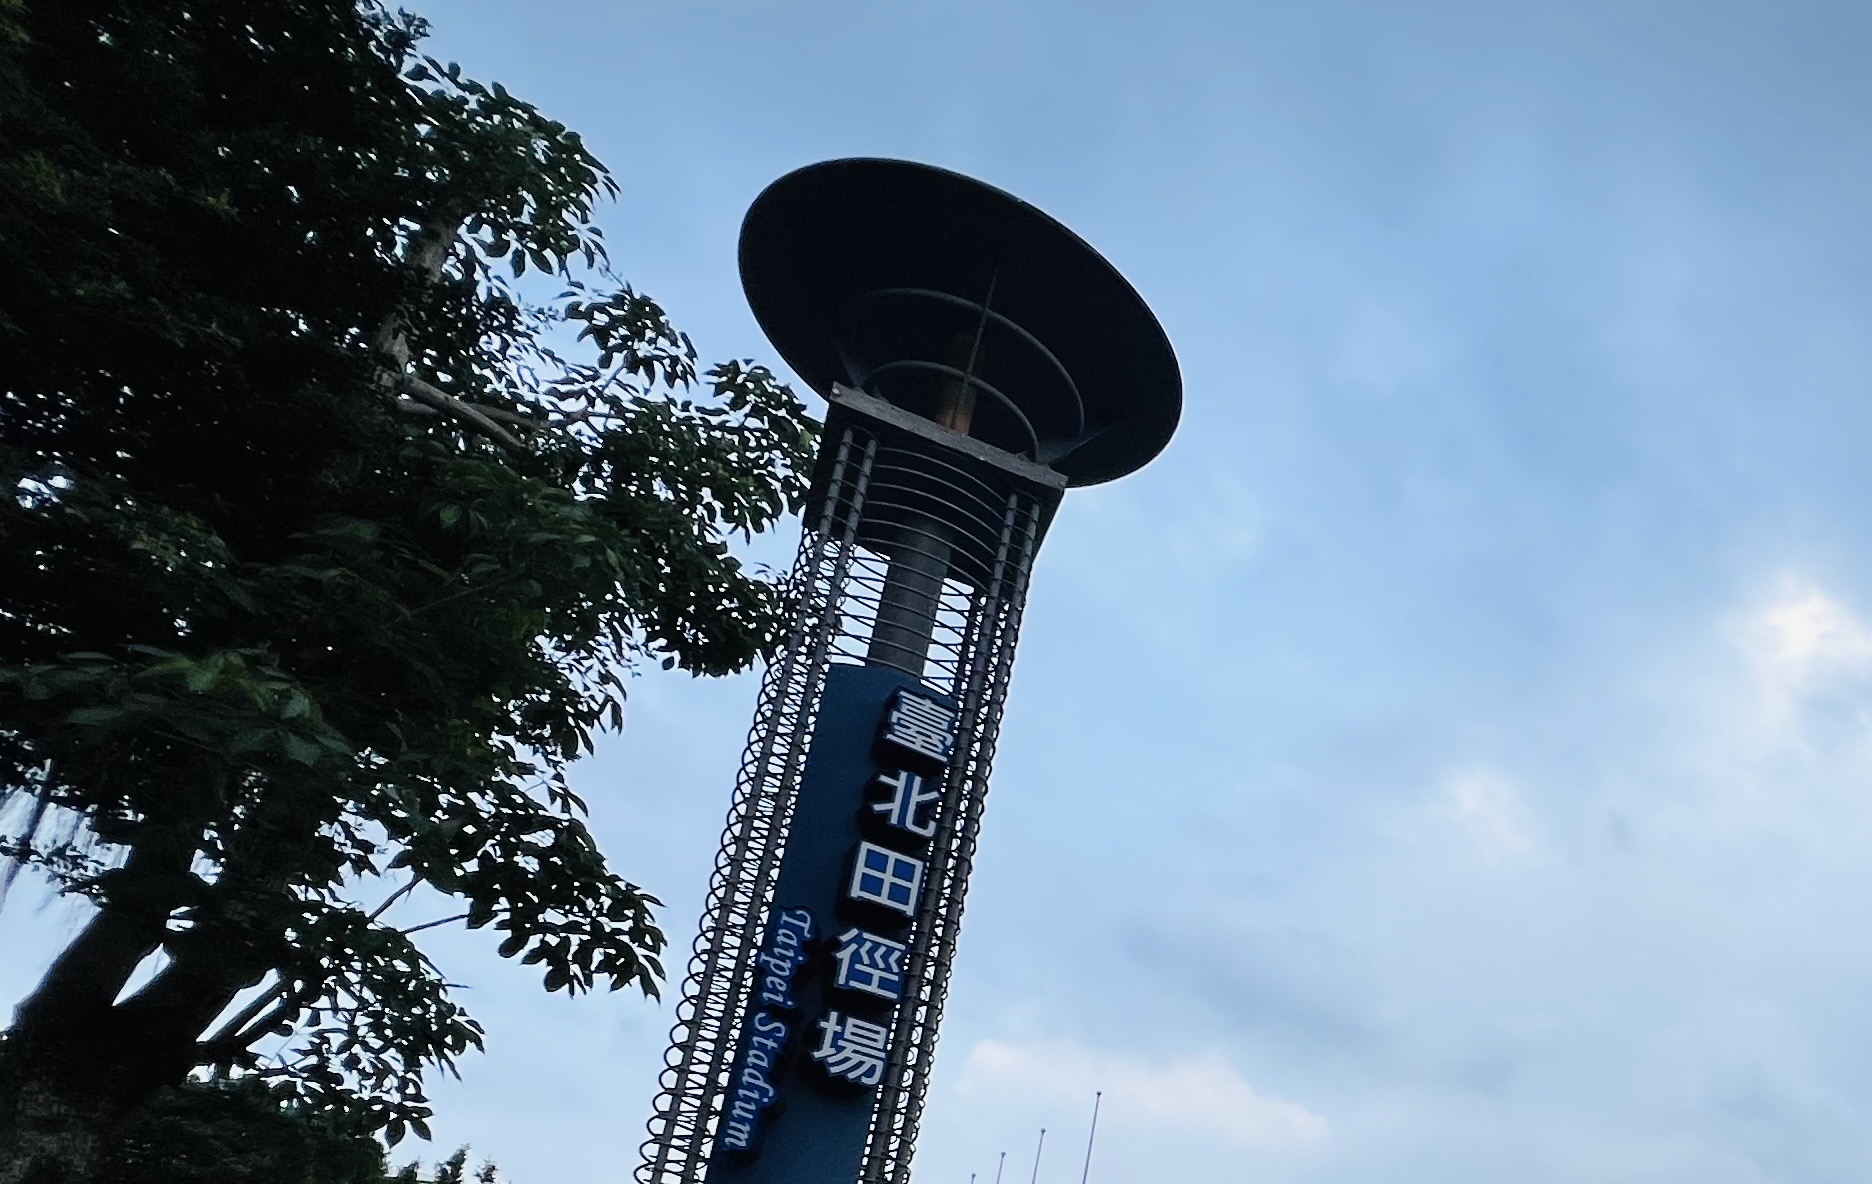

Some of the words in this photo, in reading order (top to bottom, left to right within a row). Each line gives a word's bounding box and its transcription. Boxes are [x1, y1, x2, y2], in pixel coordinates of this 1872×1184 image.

[811, 690, 956, 1086] 臺北田徑場
[758, 909, 812, 1007] Taipei
[724, 1013, 787, 1149] Stadium
